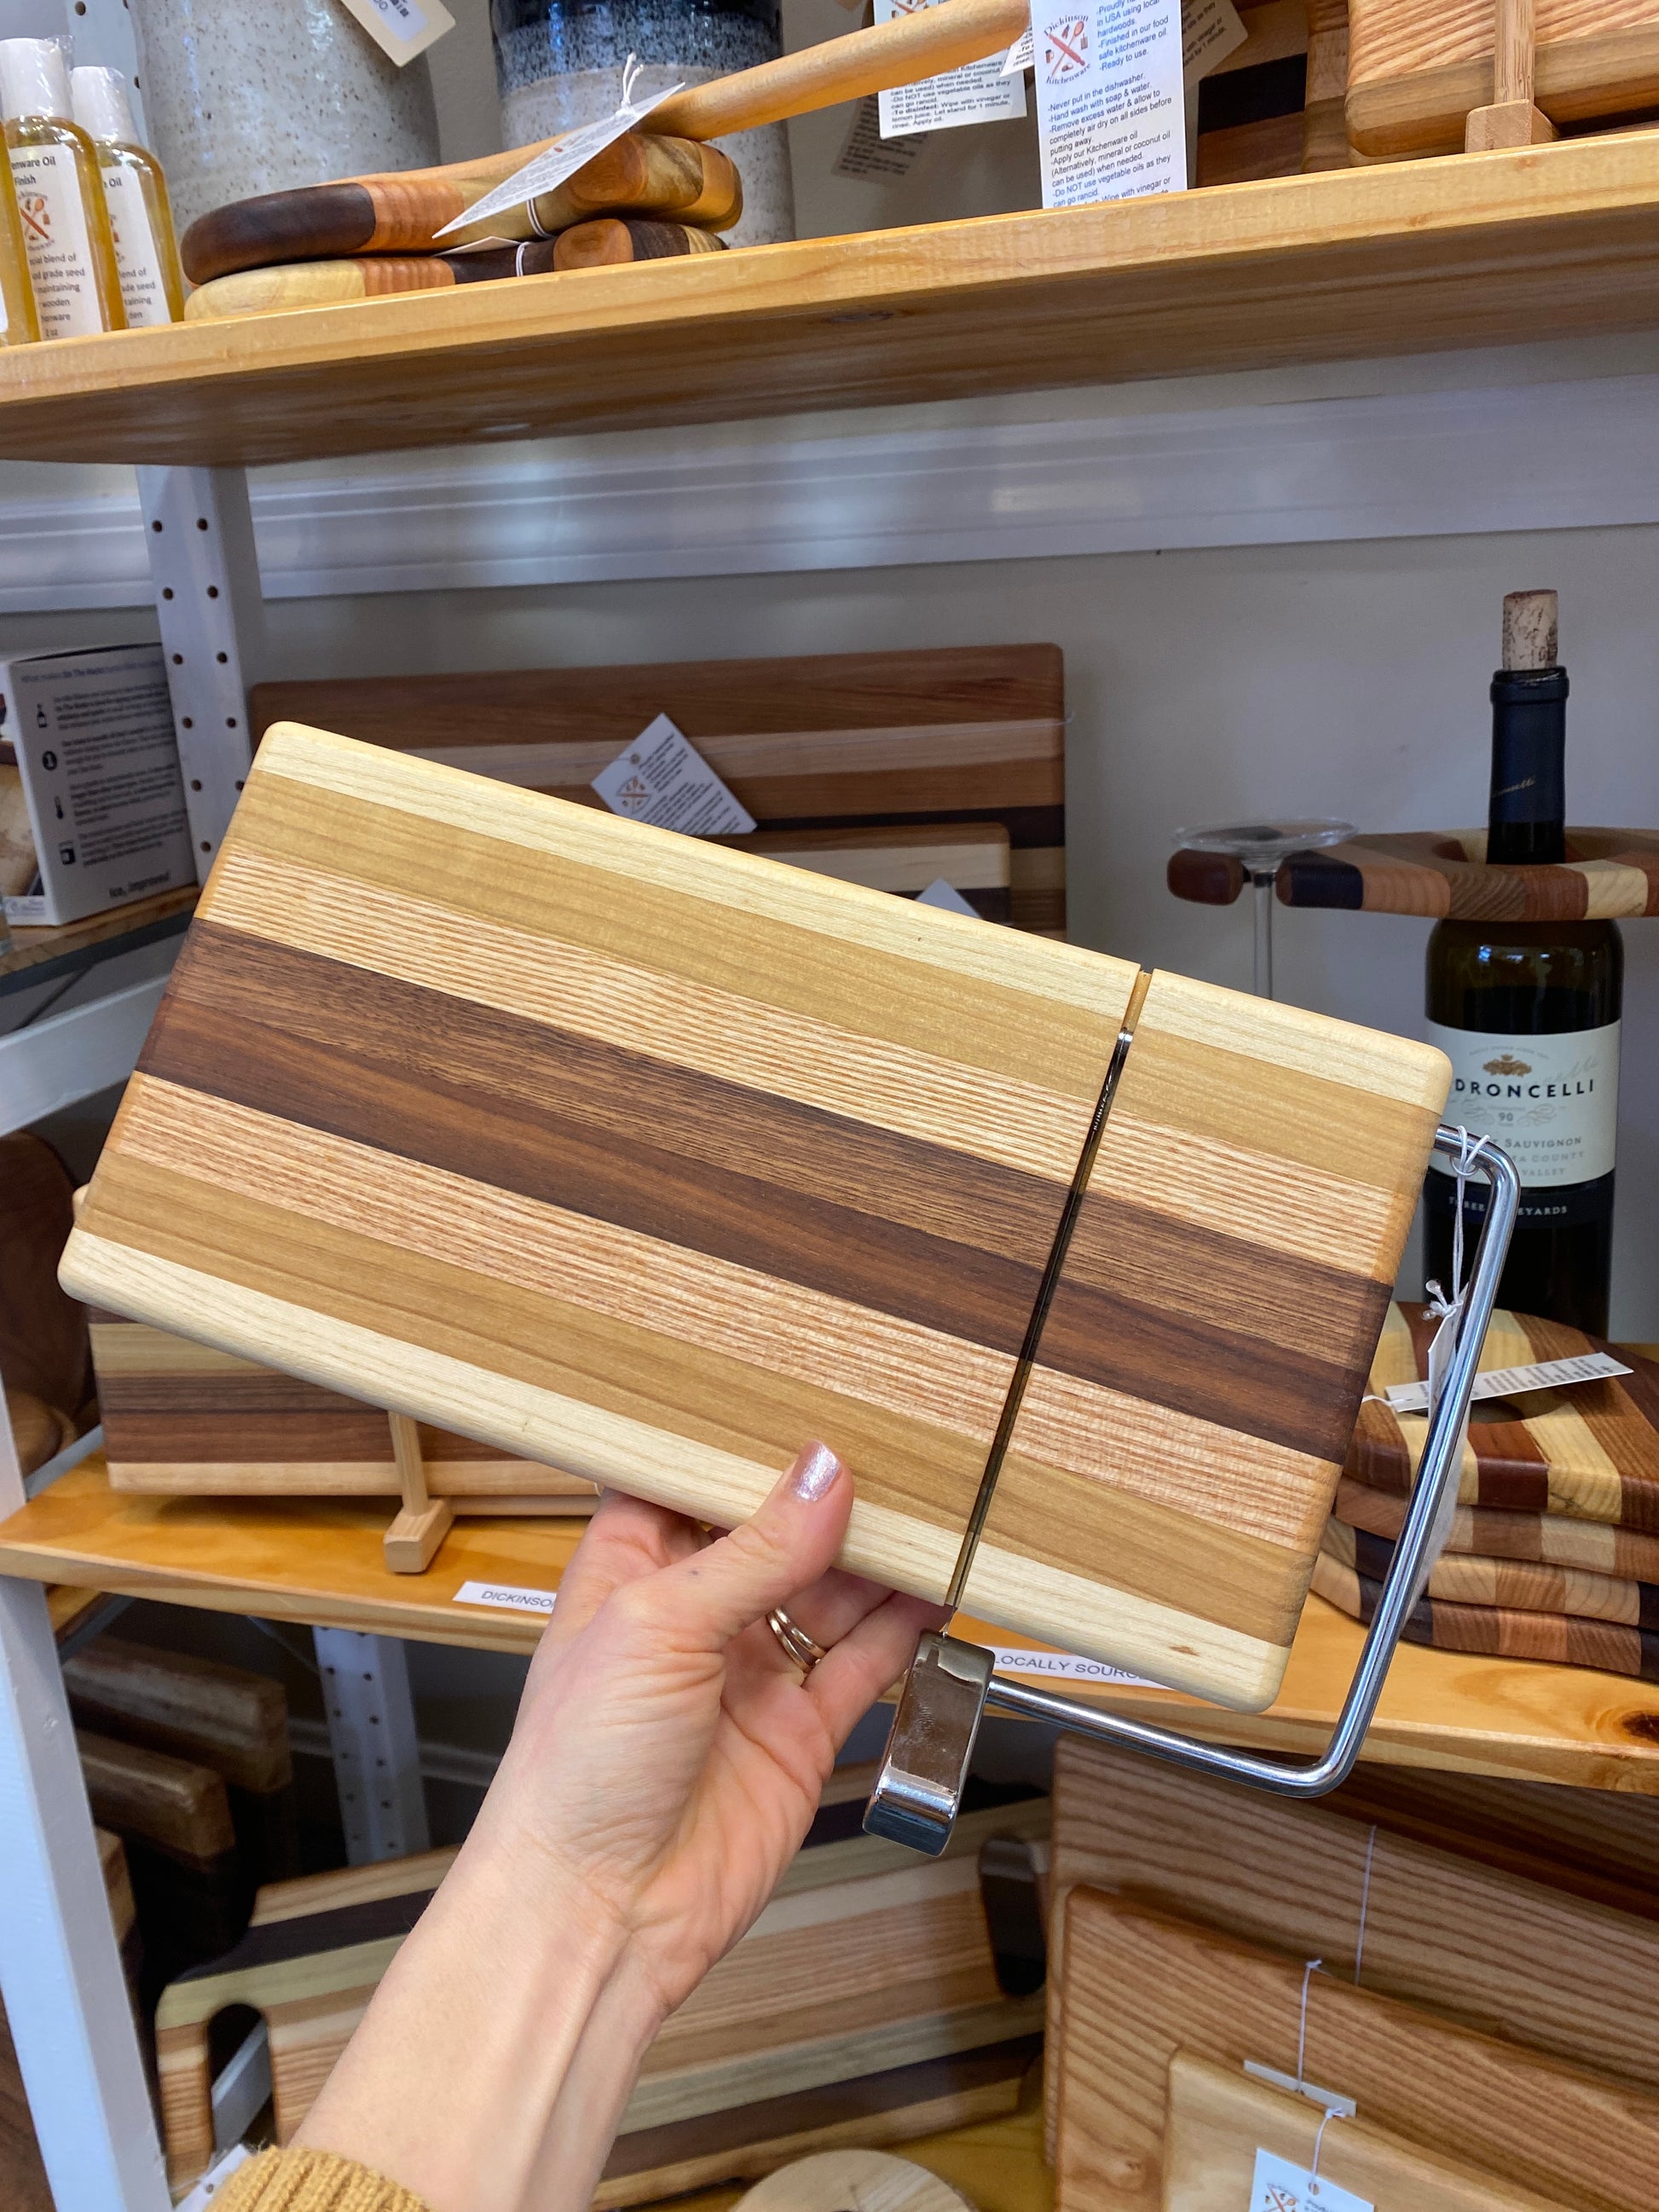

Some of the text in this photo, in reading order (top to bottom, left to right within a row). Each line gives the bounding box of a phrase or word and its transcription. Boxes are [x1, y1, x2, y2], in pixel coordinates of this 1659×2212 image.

[1105, 11, 1121, 24] USA
[1123, 4, 1142, 17] using
[1139, 24, 1151, 33] our
[1153, 14, 1169, 28] food
[1043, 14, 1089, 36] Dickinson
[1099, 48, 1113, 61] safe
[1115, 32, 1156, 55] kitchenware
[1125, 53, 1133, 62] to
[1046, 63, 1090, 84] Kitchenware
[938, 85, 970, 95] vegetable
[976, 94, 1002, 102] vinegar
[1072, 93, 1083, 106] put
[1084, 91, 1090, 101] in
[1092, 87, 1103, 98] the
[1070, 104, 1089, 116] wash
[1090, 98, 1104, 109] with
[1105, 93, 1123, 106] soap
[1124, 88, 1130, 97] &
[1081, 111, 1105, 124] excess
[1107, 102, 1125, 114] water
[1126, 98, 1133, 107] &
[1134, 94, 1152, 105] allow
[1049, 96, 1172, 145] completely air dry on all sides before
[1049, 141, 1072, 157] putting
[1051, 158, 1096, 178] (Alternatively,
[1098, 147, 1124, 162] mineral
[1133, 136, 1160, 149] coconut
[1162, 130, 1171, 141] oil
[1073, 150, 1084, 159] our
[1086, 137, 1128, 154] Kitchenware
[43, 156, 56, 166] Oil
[109, 177, 122, 188] Oil
[1051, 178, 1065, 188] can
[1066, 173, 1074, 182] be
[1076, 166, 1095, 180] used)
[1097, 162, 1115, 173] when
[1066, 182, 1082, 194] NOT
[1084, 180, 1096, 188] use
[1098, 168, 1130, 183] vegetable
[1132, 162, 1145, 173] oils
[1146, 160, 1154, 169] as
[1155, 154, 1171, 166] they
[1121, 188, 1135, 198] with
[1136, 180, 1162, 193] vinegar
[1163, 176, 1171, 185] or
[1066, 197, 1076, 206] go
[43, 252, 66, 263] blend
[68, 252, 76, 262] of
[66, 267, 85, 277] seed
[1455, 1078, 1594, 1098] DRONCELLI
[1499, 1112, 1514, 1123] 90
[1522, 1167, 1566, 1177] VALLEY
[482, 1591, 554, 1608] DICKINSO
